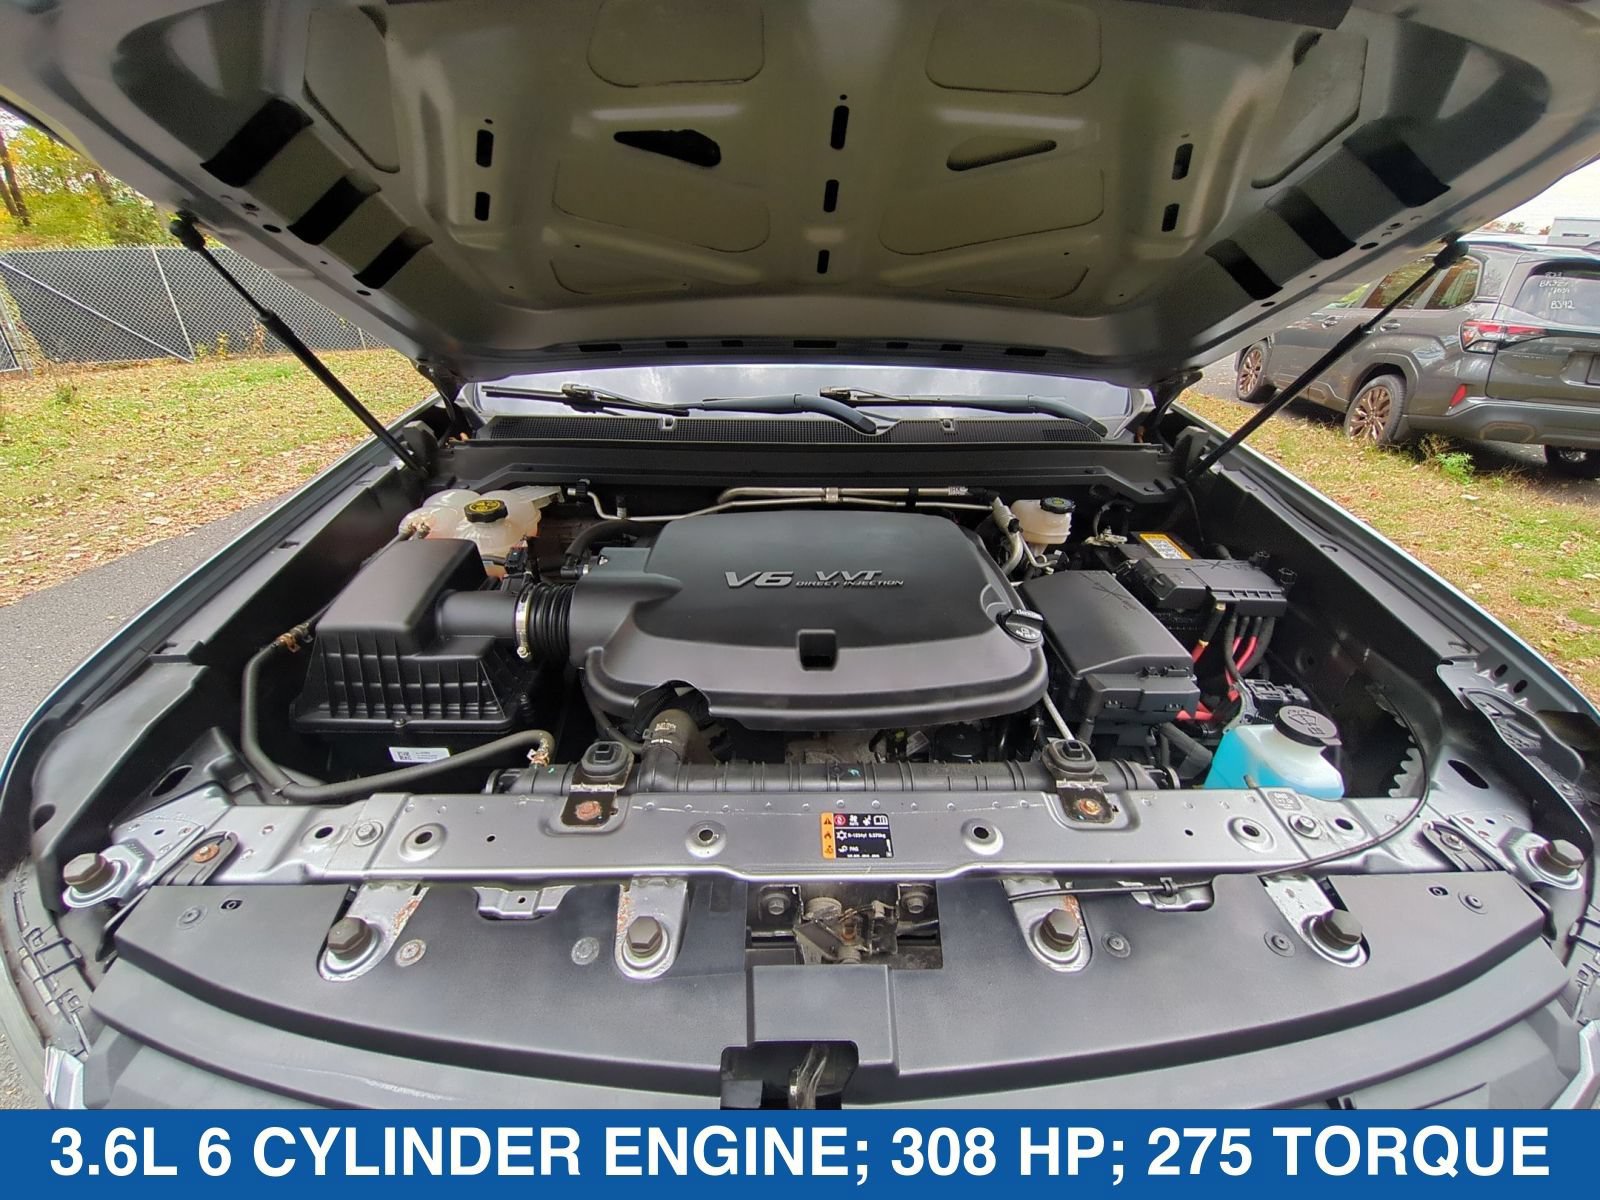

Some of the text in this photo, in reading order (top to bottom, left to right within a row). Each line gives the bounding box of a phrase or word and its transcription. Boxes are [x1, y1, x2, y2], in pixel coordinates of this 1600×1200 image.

[724, 570, 883, 587] V6 VVT
[795, 580, 905, 588] DIRECT INJECTION
